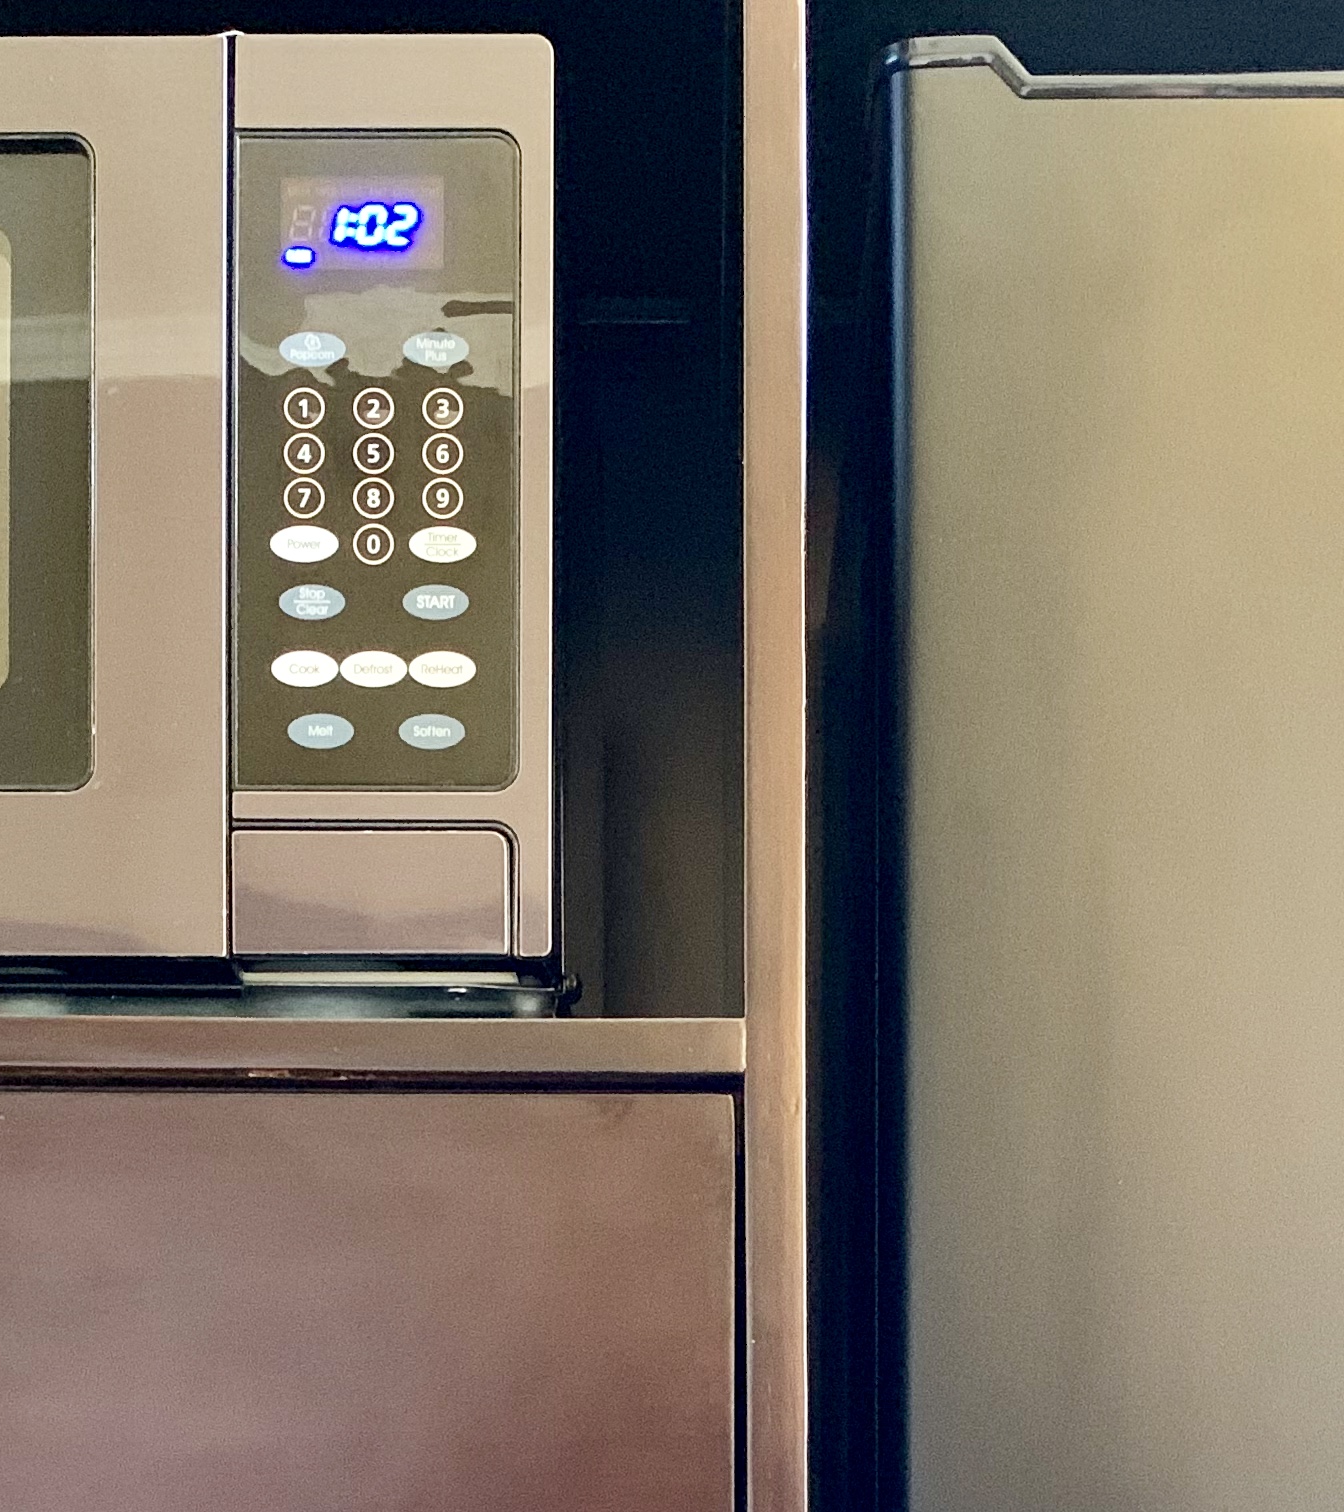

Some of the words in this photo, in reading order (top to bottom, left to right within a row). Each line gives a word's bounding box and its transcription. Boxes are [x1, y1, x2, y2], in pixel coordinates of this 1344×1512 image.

[416, 337, 456, 349] Minute
[425, 350, 447, 362] Plus
[297, 398, 309, 418] 1
[366, 398, 381, 418] 2
[436, 398, 450, 418] 3
[296, 443, 312, 464] 4
[367, 443, 380, 464] 5
[435, 443, 450, 464] 6
[297, 488, 312, 508] 7
[366, 487, 381, 508] 8
[435, 488, 450, 508] 9
[287, 538, 321, 550] Power
[366, 534, 381, 555] 0
[427, 532, 458, 544] Timer
[426, 546, 459, 558] Clock
[298, 587, 326, 601] Stop
[295, 603, 329, 616] Clear
[416, 594, 456, 610] START
[289, 663, 320, 675] Cook
[354, 663, 393, 675] Defrost
[308, 725, 333, 737] Melt
[413, 725, 451, 738] Soften
